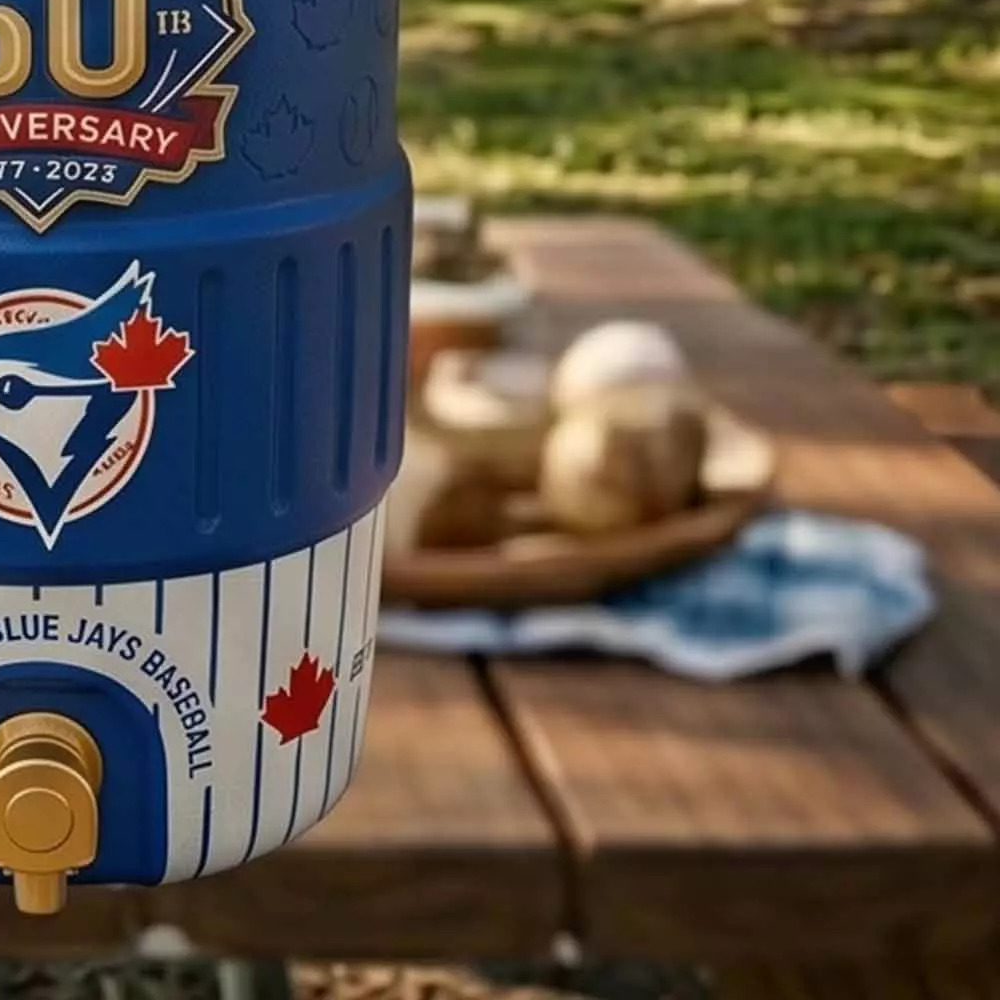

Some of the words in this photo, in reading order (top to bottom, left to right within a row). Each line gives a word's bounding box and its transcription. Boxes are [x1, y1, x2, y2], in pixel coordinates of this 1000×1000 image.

[46, 160, 117, 183] 2023
[68, 618, 142, 660] JAYS
[140, 649, 212, 779] BASEBALL
